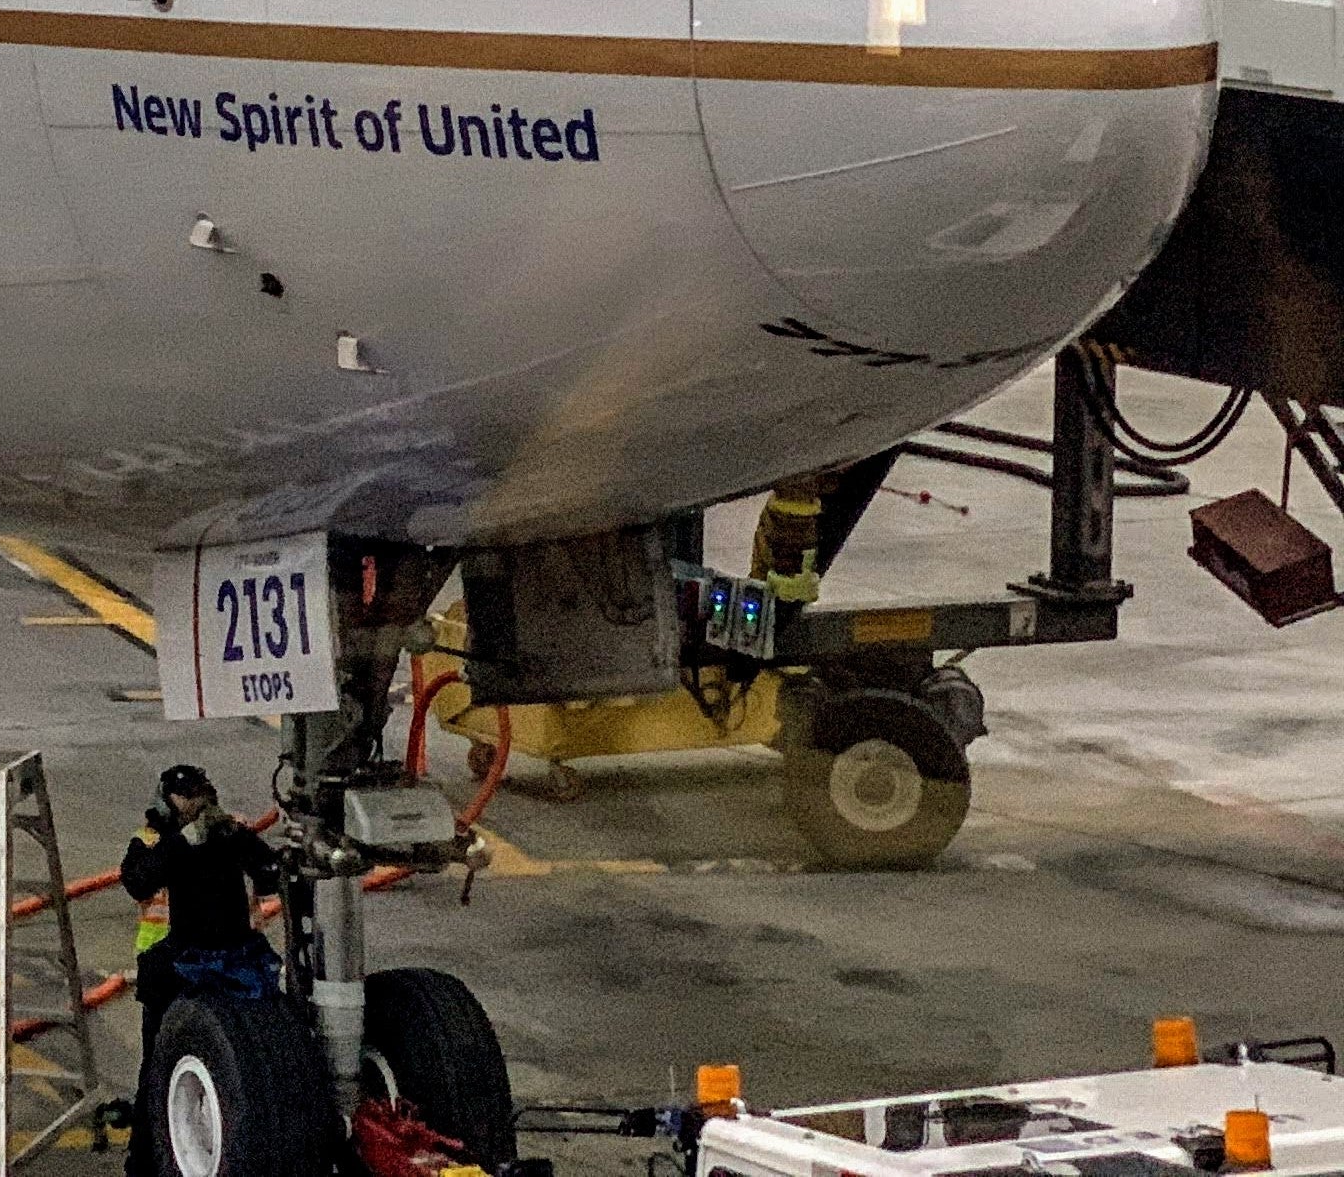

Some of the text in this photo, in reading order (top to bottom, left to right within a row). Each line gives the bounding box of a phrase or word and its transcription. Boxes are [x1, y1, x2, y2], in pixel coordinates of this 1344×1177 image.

[111, 83, 600, 163] New Spirit of United
[216, 572, 311, 662] 2131
[241, 671, 294, 702] ETOPS
